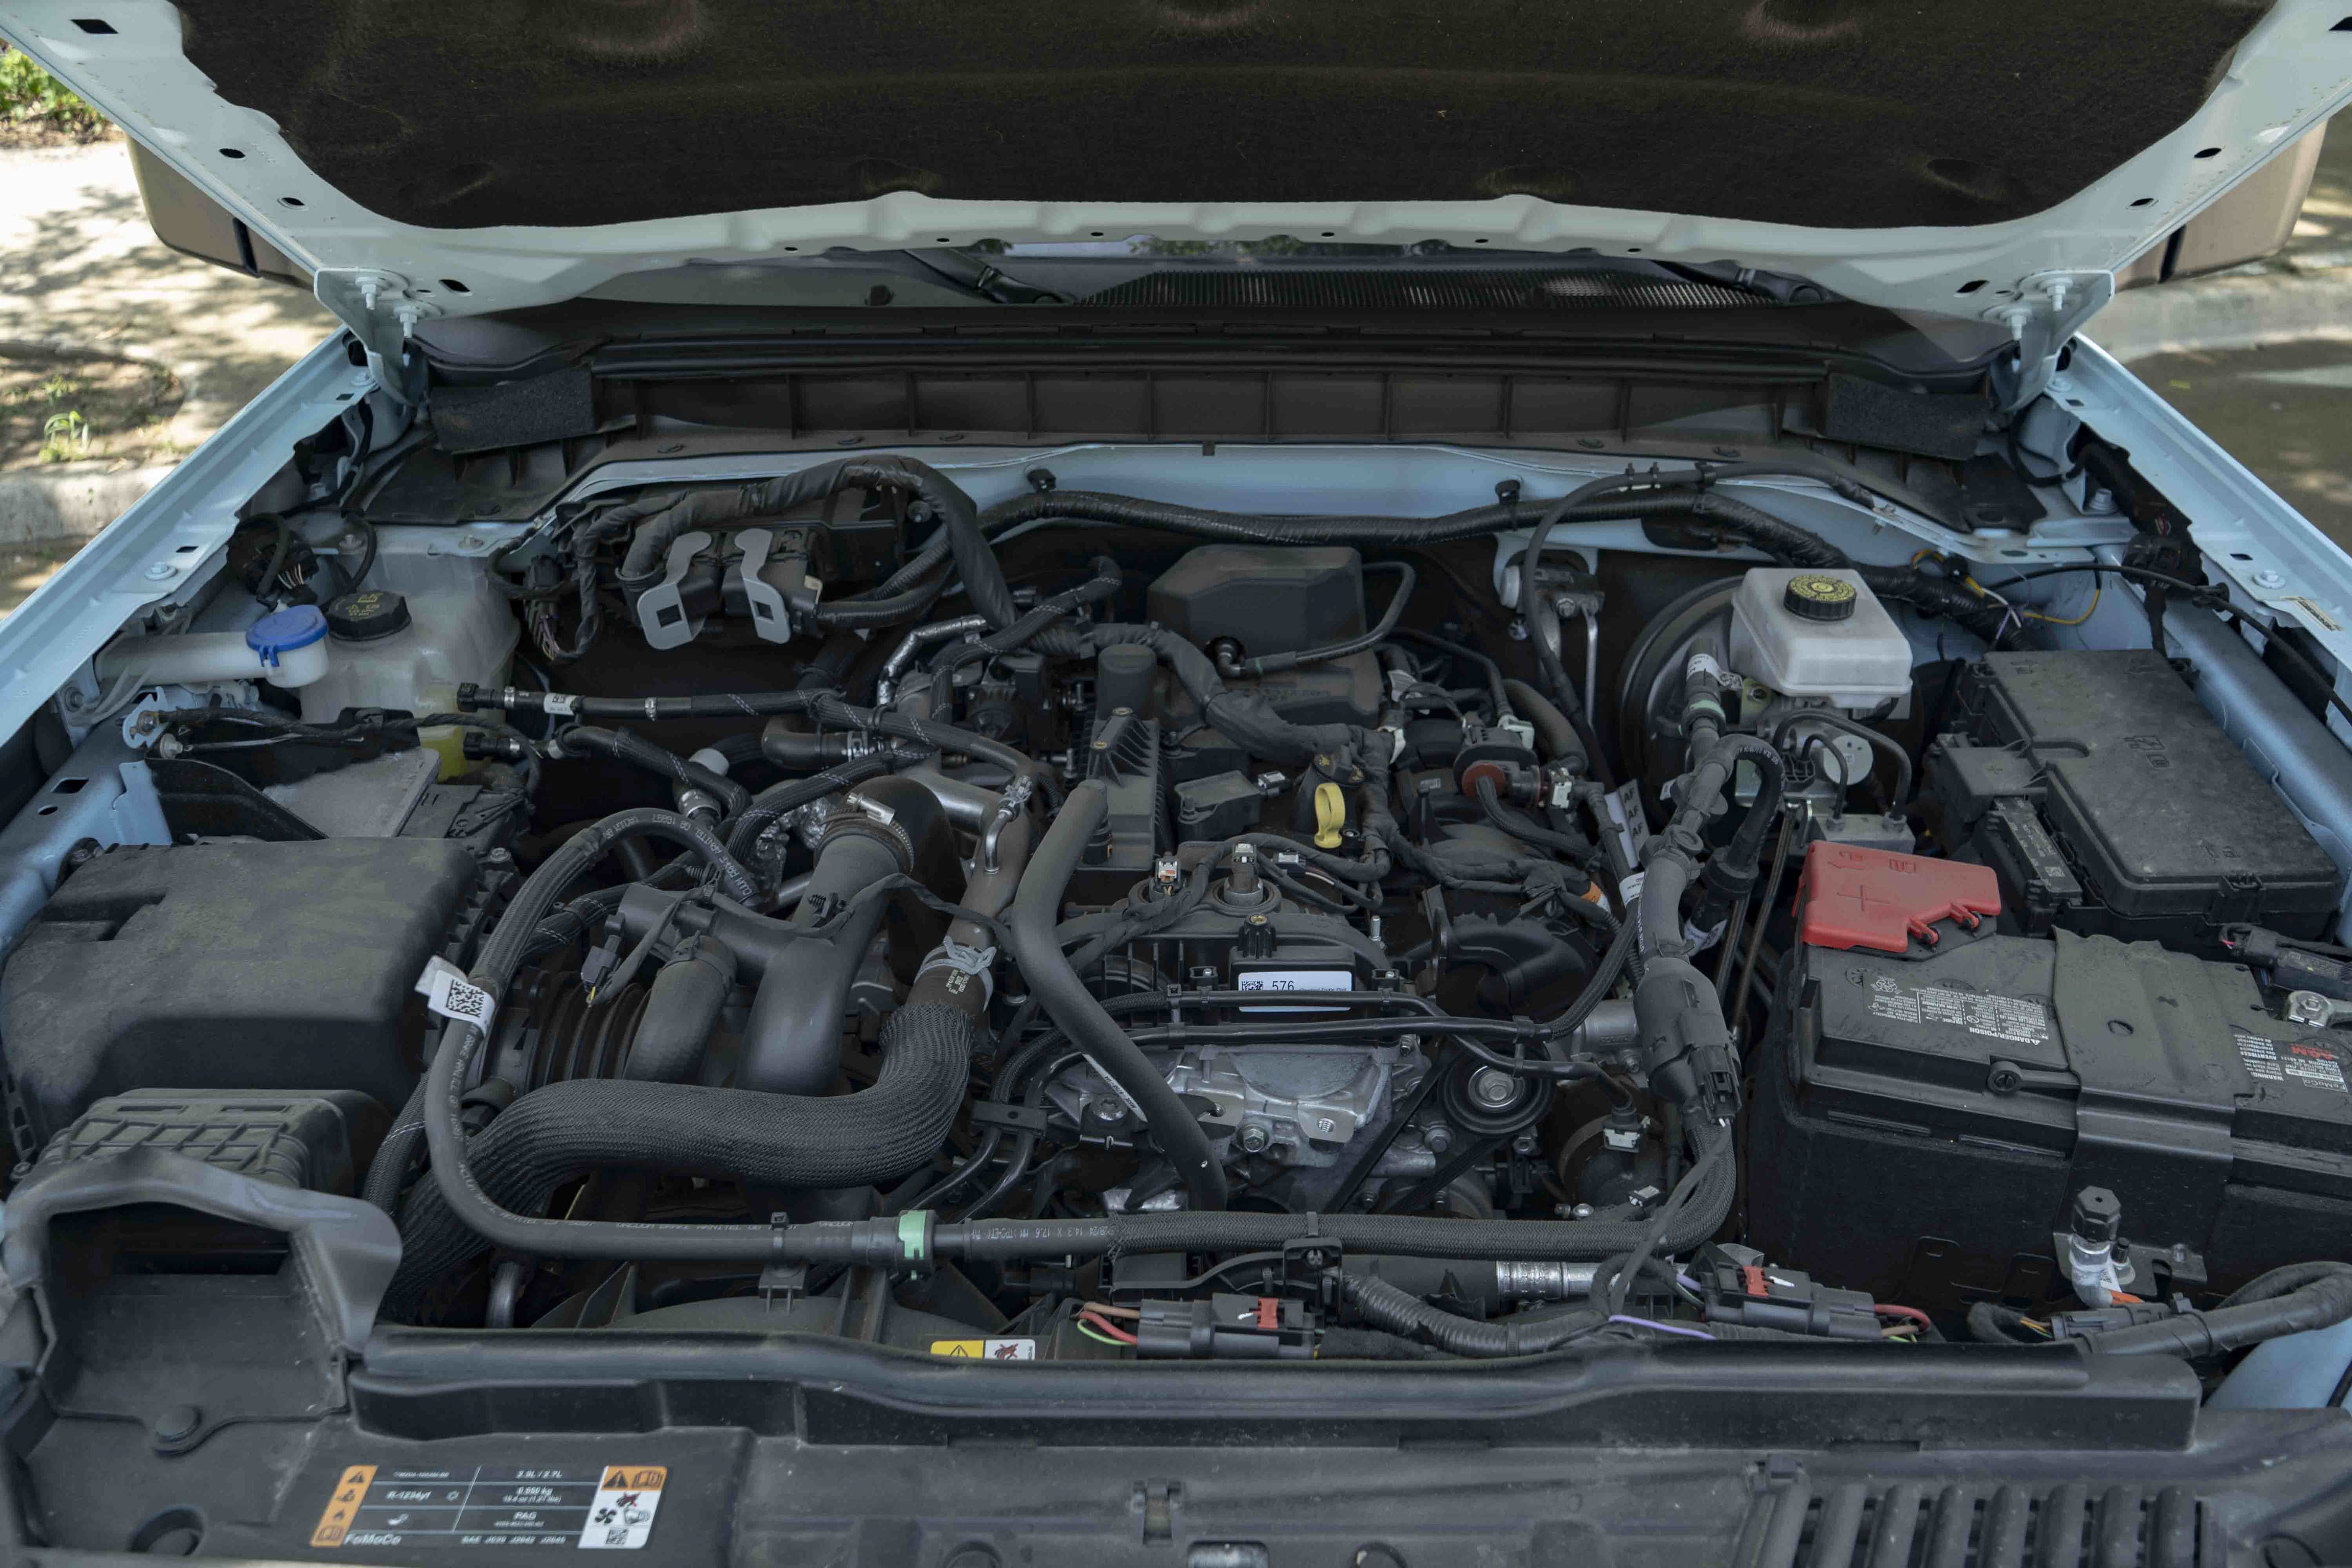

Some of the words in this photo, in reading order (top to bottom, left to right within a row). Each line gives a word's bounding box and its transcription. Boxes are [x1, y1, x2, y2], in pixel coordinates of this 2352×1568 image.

[1272, 981, 1294, 990] 576
[1969, 1027, 2031, 1044] DANGER/POISON
[2305, 1080, 2345, 1090] FoMoCo
[513, 1512, 537, 1520] PAG
[344, 1533, 402, 1545] FoMoCo
